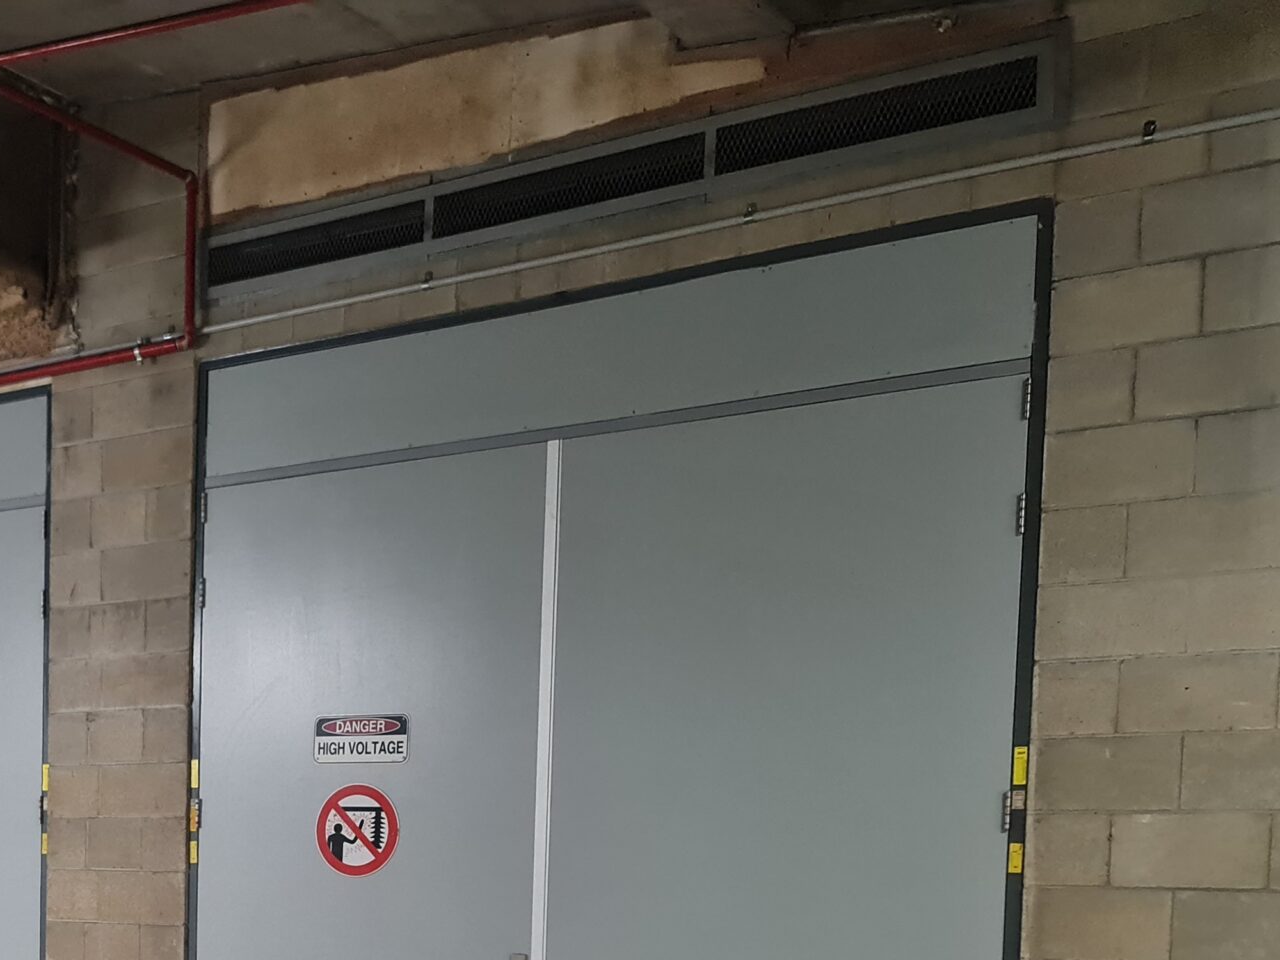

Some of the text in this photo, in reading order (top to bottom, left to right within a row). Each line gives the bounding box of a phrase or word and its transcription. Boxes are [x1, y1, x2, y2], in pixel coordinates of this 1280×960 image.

[336, 721, 385, 733] DANGER
[318, 741, 404, 755] HIGH VOLTAGE
